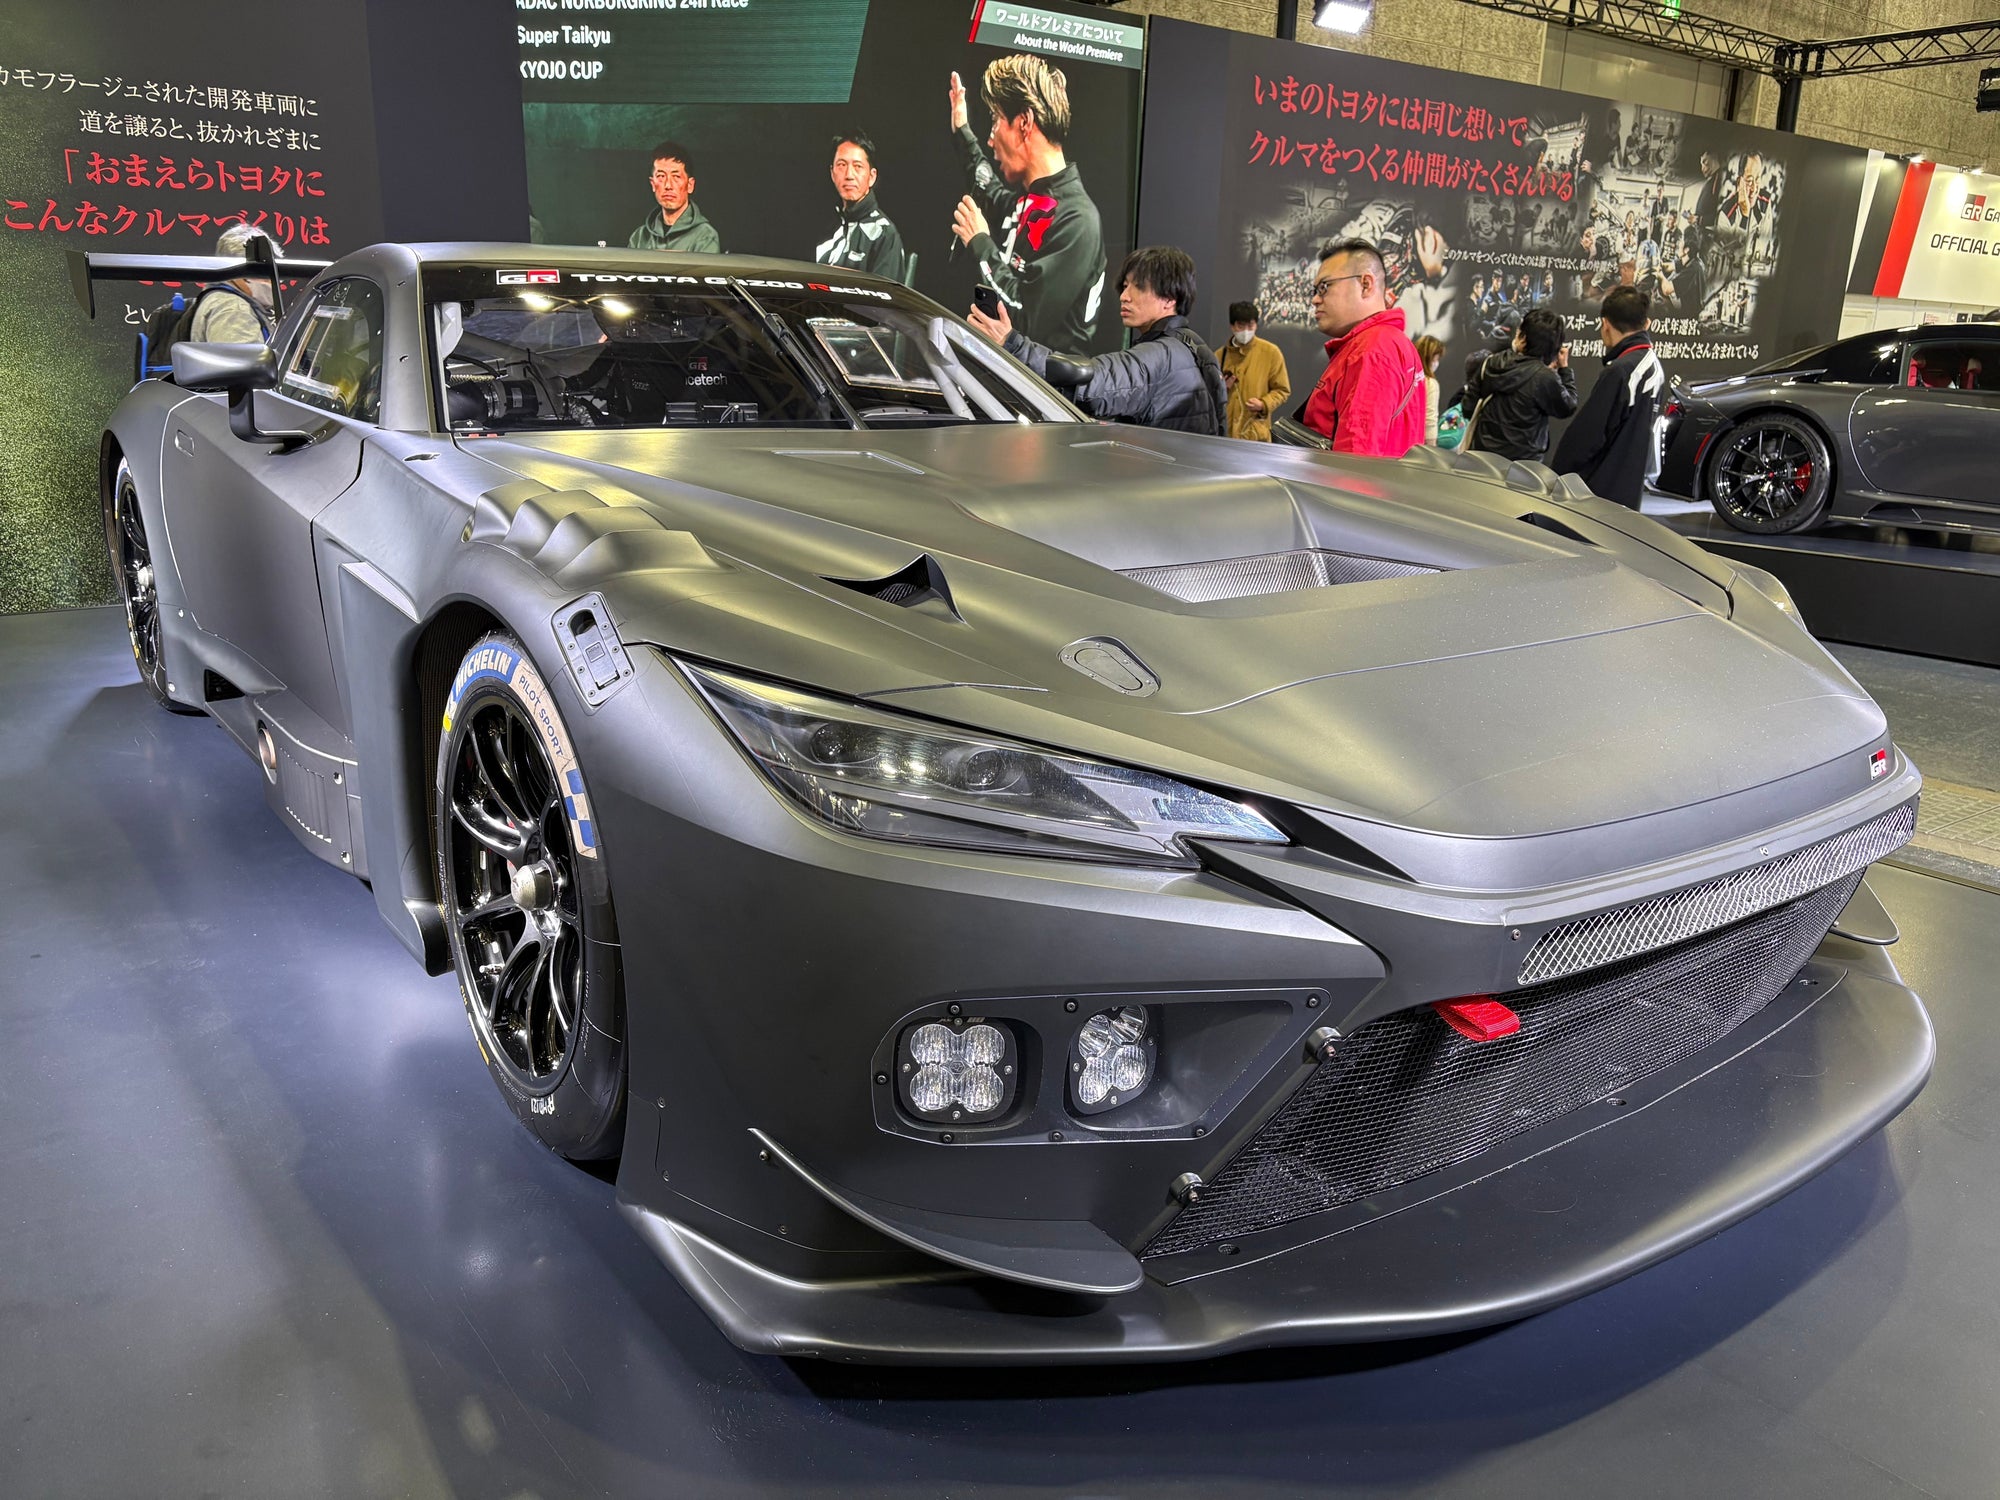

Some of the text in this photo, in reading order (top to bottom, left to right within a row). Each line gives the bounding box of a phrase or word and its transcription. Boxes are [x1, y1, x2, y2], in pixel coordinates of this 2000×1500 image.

[517, 25, 611, 48] Super Taikyu
[996, 8, 1124, 44] ワールドプレミアについて
[1014, 32, 1124, 62] About the World Premiere
[569, 60, 603, 79] CUP
[1254, 74, 1528, 147] いまのトヨタには同じ想いで
[79, 108, 322, 151] 道を譲ると、抜かれざまに
[64, 148, 326, 198] 「おまえらトヨタに
[1248, 129, 1574, 202] クルマをつくる仲間がたくさんいる
[1961, 202, 1984, 221] GR
[1930, 233, 1988, 255] OFFICIAL
[498, 272, 560, 285] GR
[570, 273, 698, 284] TOYOTA
[807, 282, 892, 301] Racing
[455, 648, 513, 697] MICHELIN
[518, 675, 564, 757] PILOT SPORT
